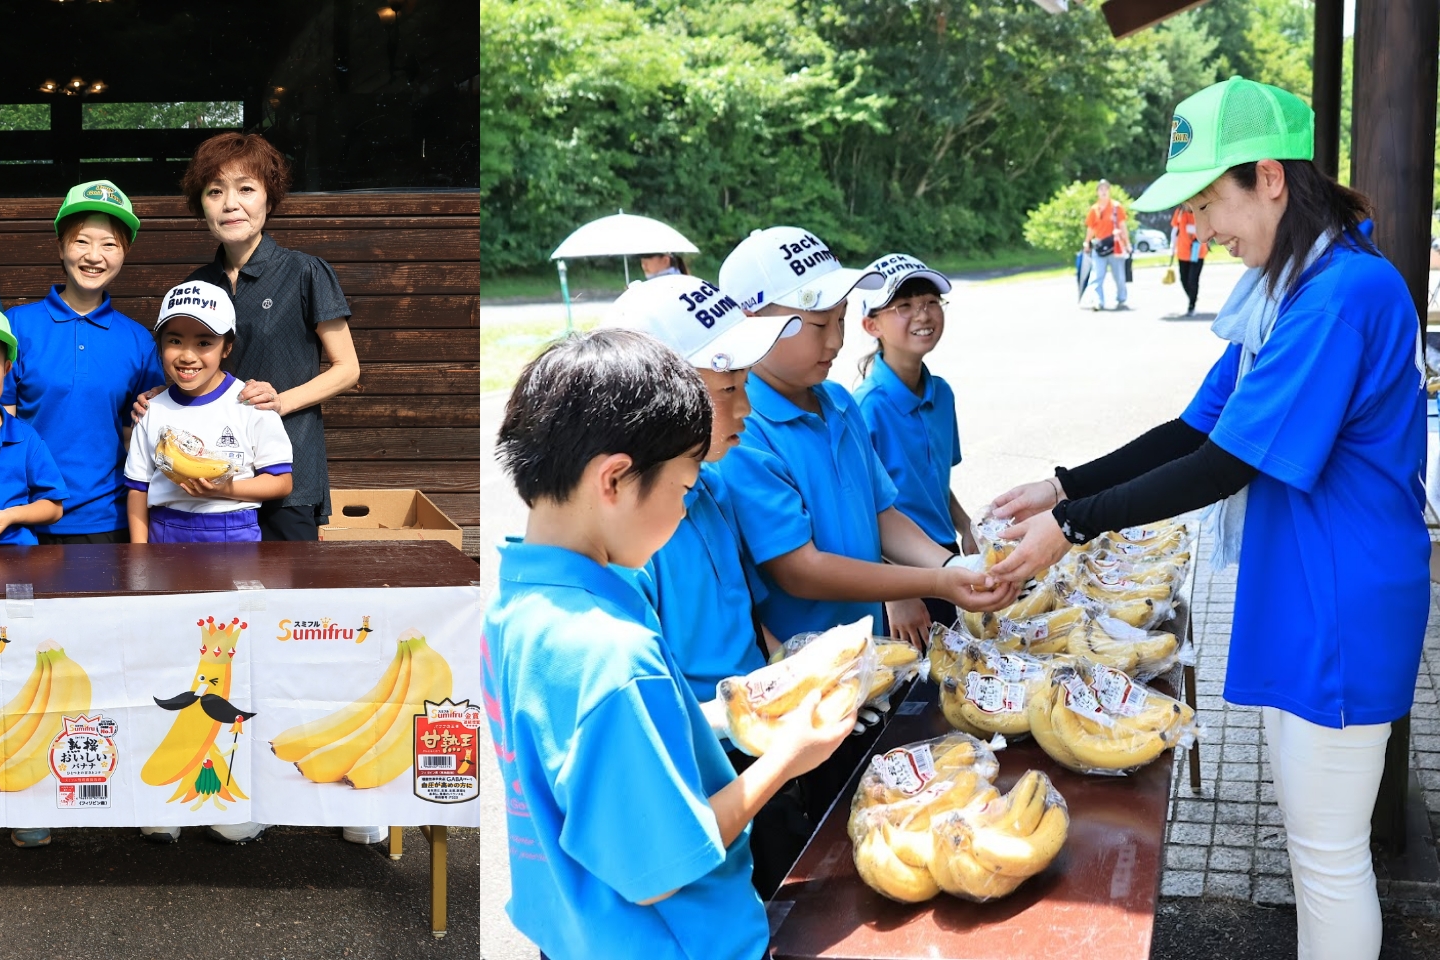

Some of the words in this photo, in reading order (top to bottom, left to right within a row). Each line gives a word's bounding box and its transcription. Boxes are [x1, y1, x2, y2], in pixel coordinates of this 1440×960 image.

[779, 234, 819, 260] Jack
[874, 254, 907, 272] Jack
[169, 286, 200, 299] Jack
[167, 297, 217, 311] Bunny!!
[276, 618, 353, 642] Sumifru
[294, 620, 320, 628] スミフル
[431, 708, 463, 719] Sumifru
[69, 724, 95, 732] Sumifru
[100, 726, 114, 735] No.1
[420, 729, 474, 754] 甘熟王
[60, 752, 107, 763] おいしい
